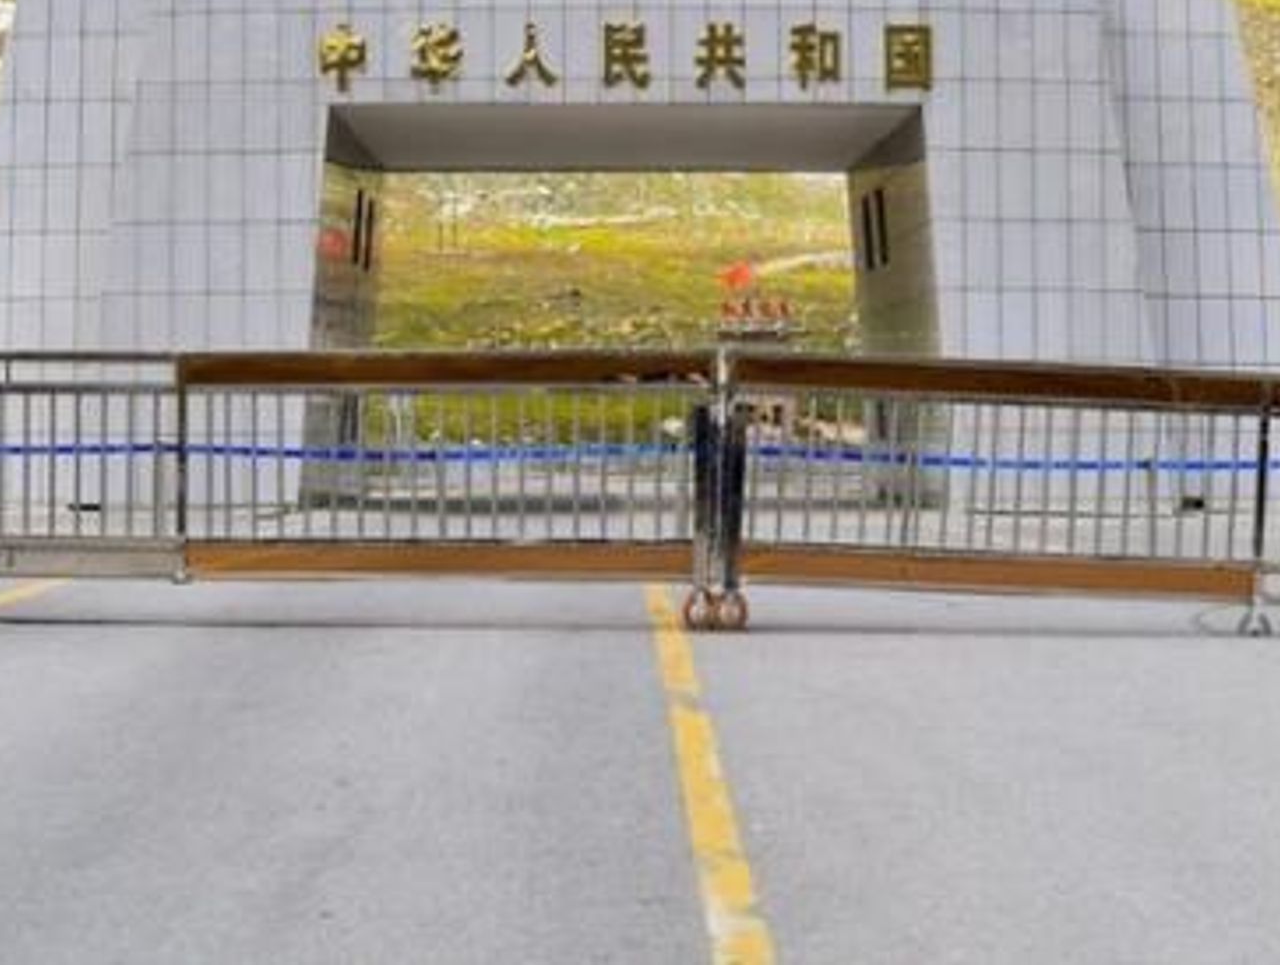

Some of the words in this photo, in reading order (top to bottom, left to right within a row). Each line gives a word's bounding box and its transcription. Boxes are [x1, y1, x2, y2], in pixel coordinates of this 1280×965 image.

[317, 22, 935, 93] 中华人民共和国
